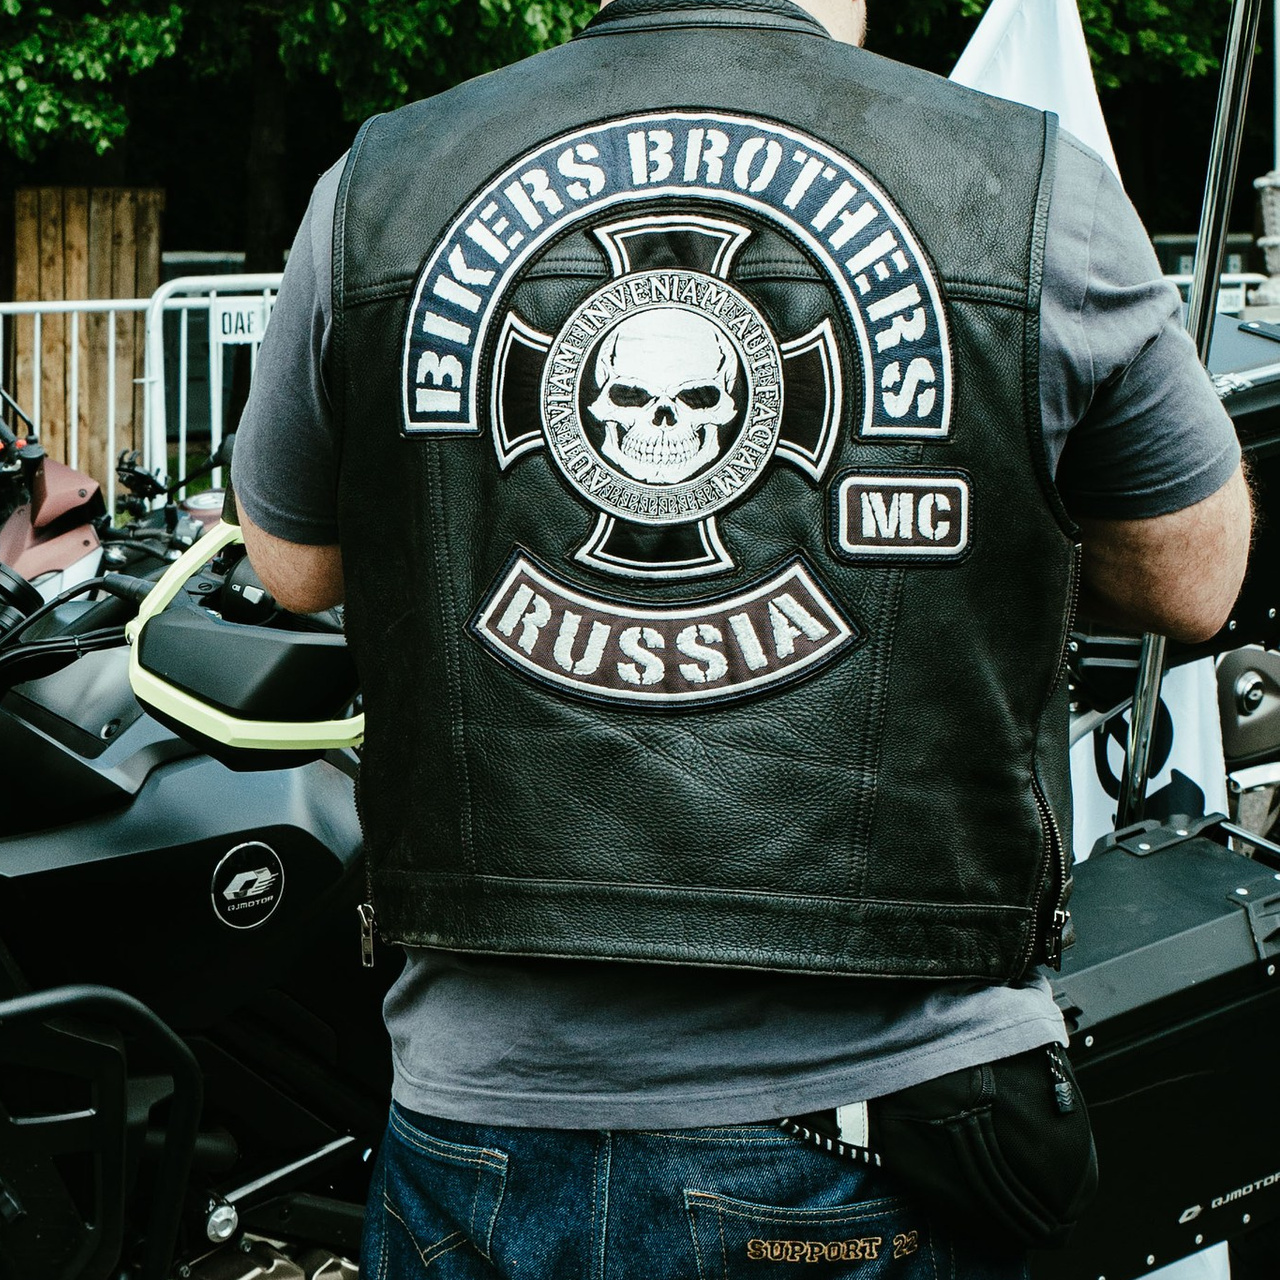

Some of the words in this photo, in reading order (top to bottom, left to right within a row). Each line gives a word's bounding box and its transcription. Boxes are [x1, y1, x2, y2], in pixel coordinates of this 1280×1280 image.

[415, 141, 607, 415] BIKERS
[626, 127, 940, 420] BROTHERS
[579, 274, 730, 338] INVENIAM
[727, 313, 778, 370] AUT
[548, 341, 583, 424] VIAM
[559, 438, 612, 496] AUT
[712, 383, 779, 497] FACIAM
[859, 489, 952, 541] MC
[501, 581, 829, 687] RUSSIA
[227, 894, 274, 912] QJMOTOR
[1211, 1171, 1280, 1209] QJMOTOR
[747, 1236, 882, 1263] SUPPORT
